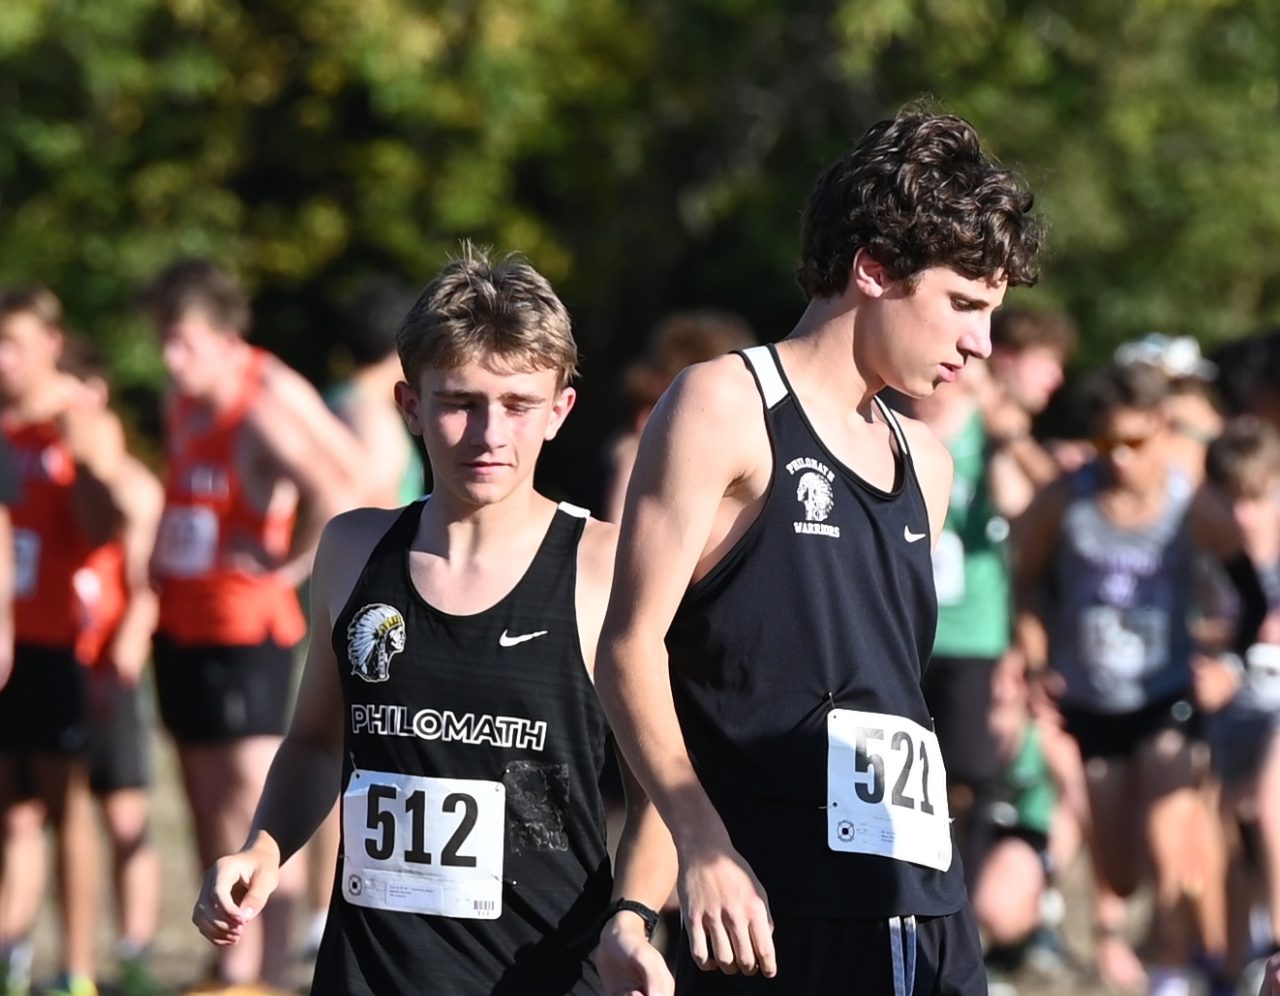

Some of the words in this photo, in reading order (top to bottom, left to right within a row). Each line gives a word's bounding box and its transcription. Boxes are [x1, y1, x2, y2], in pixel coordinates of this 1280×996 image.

[785, 457, 836, 483] PHILOMATH
[793, 521, 841, 538] WARRIORS
[351, 704, 548, 752] PHILOMATH
[854, 726, 935, 816] 521
[364, 783, 479, 868] 512
